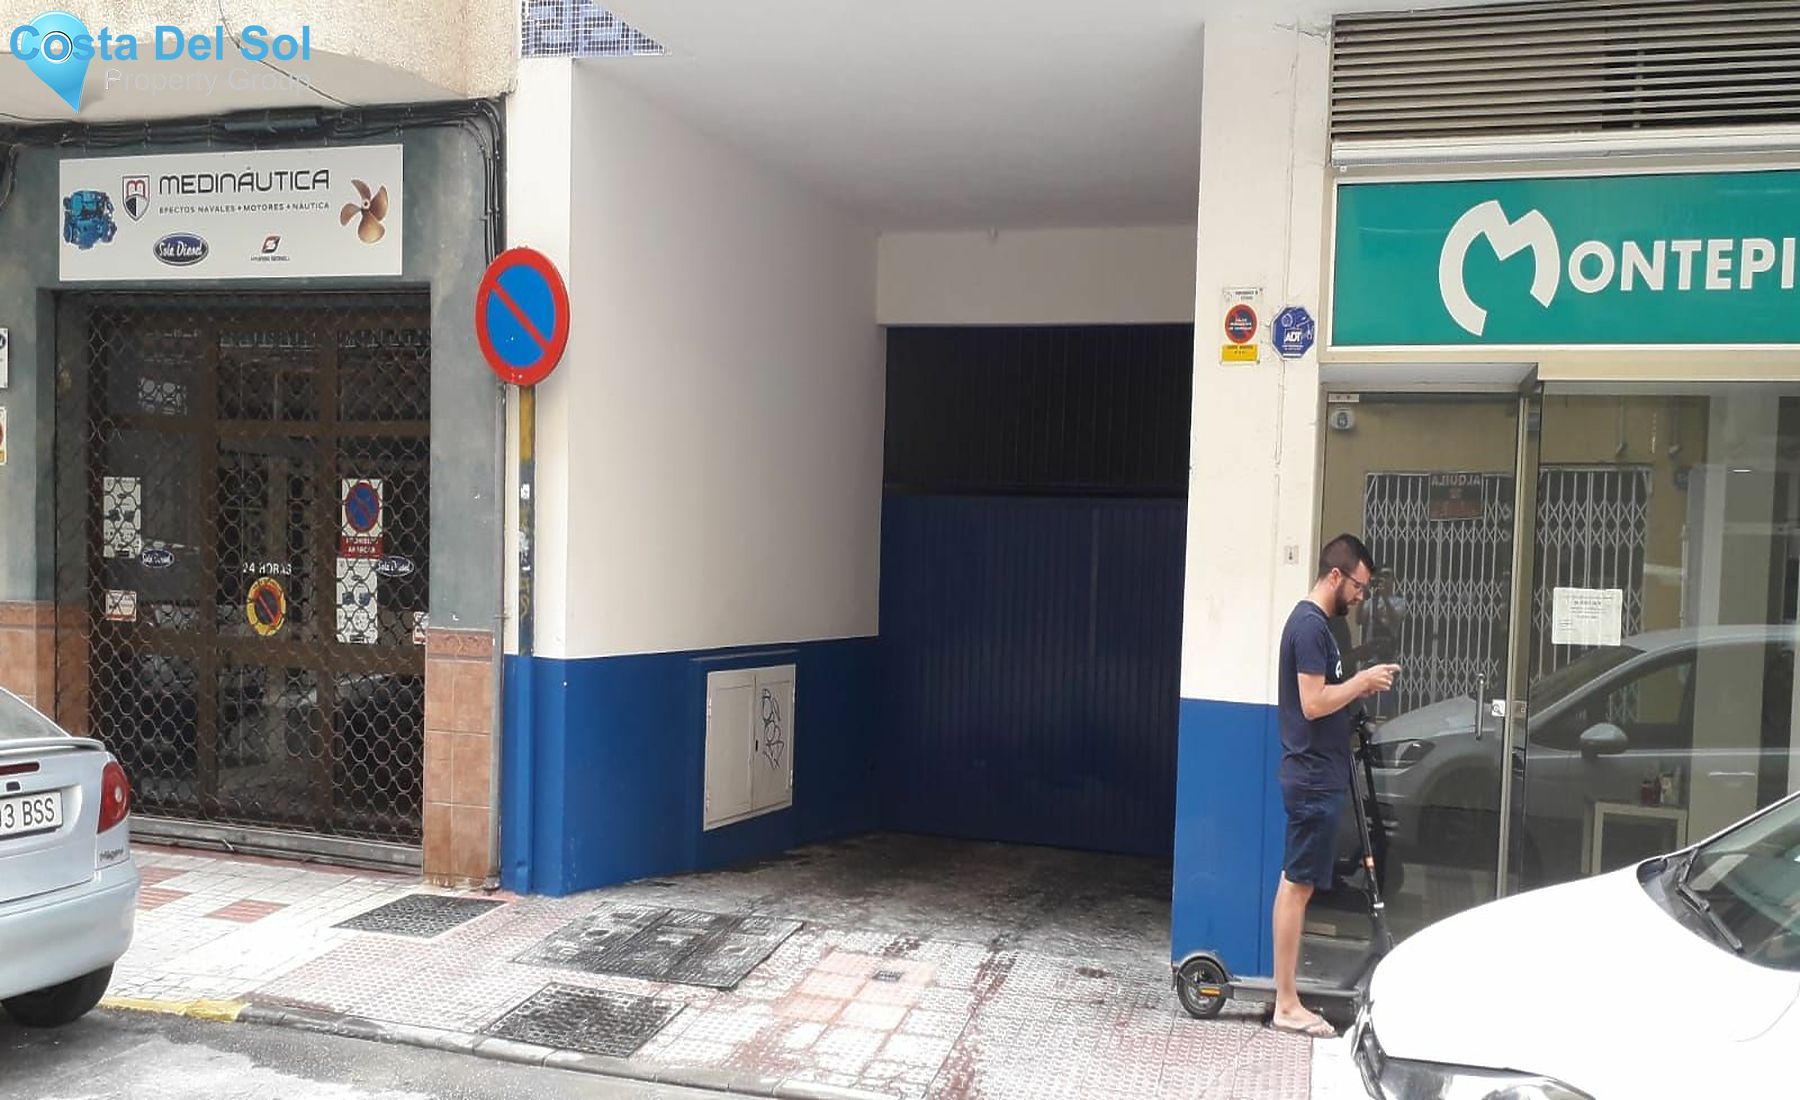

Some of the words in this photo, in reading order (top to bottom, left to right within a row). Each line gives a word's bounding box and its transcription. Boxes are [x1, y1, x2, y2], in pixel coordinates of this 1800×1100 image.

[159, 205, 196, 214] EFECTOS
[198, 204, 235, 213] NAVALES
[243, 203, 284, 212] MOTORES
[1284, 331, 1302, 342] ADT
[242, 562, 255, 573] 24
[0, 803, 15, 829] 3
[22, 797, 55, 827] BSS
